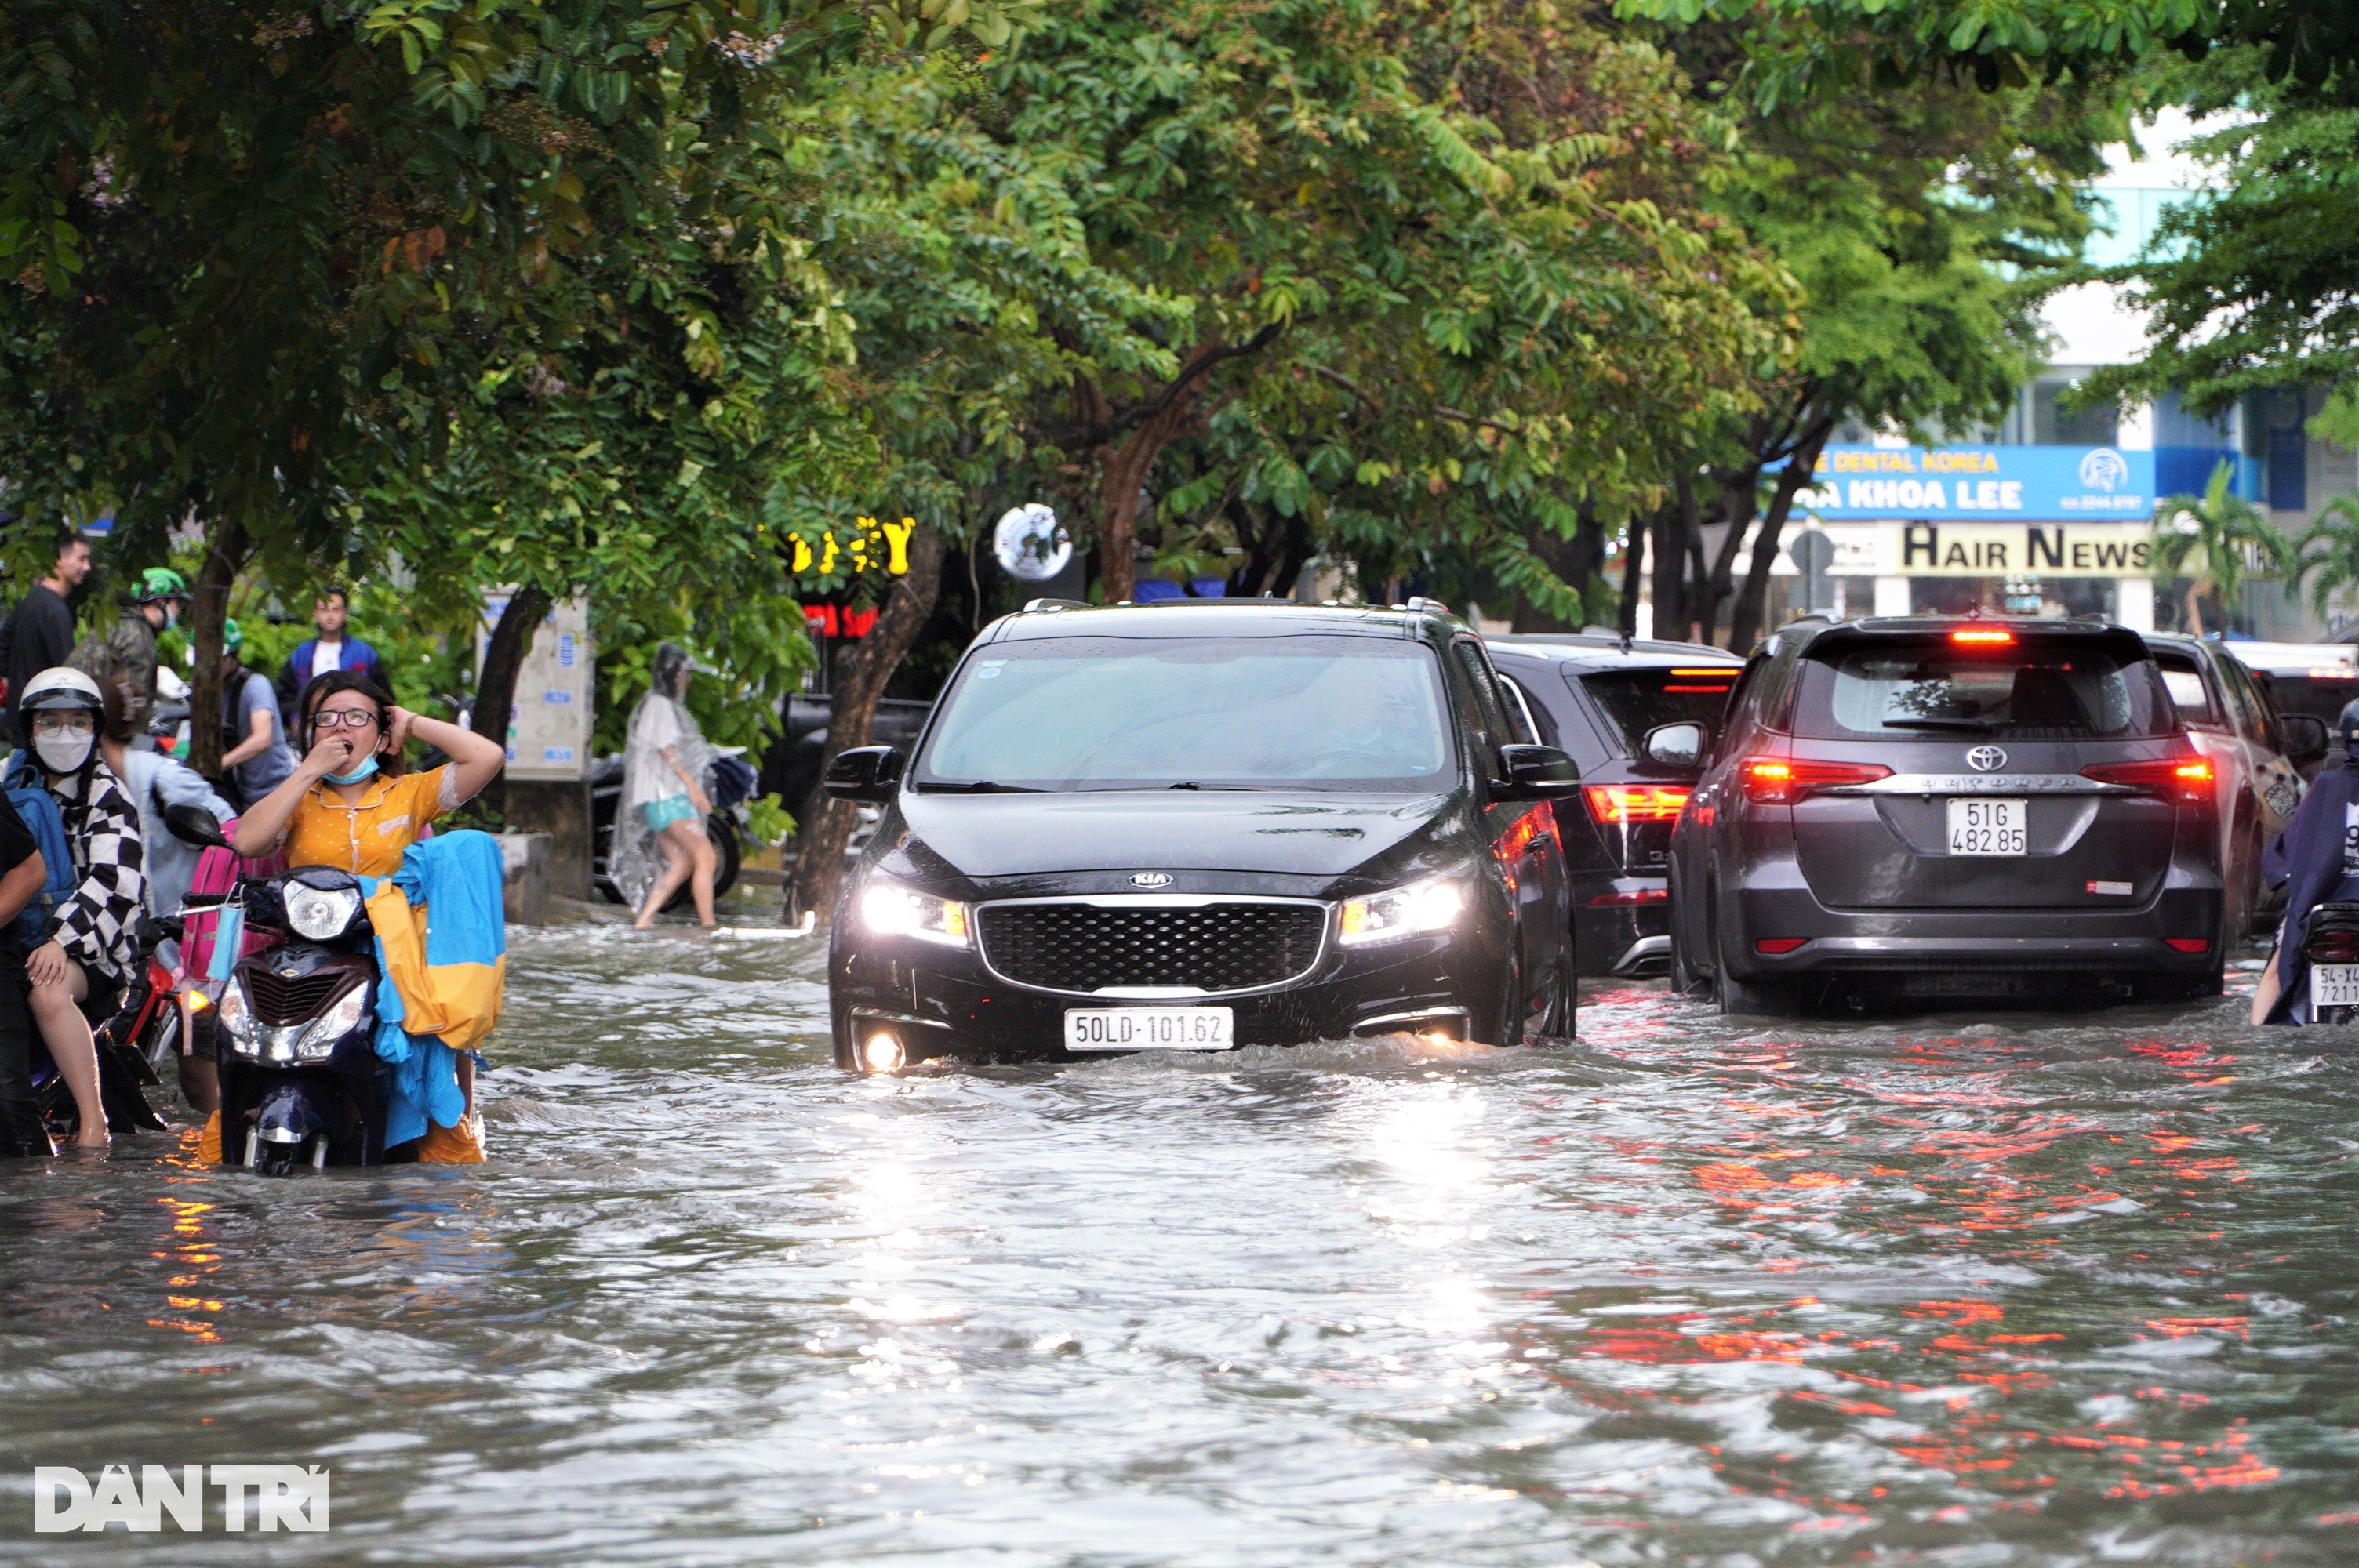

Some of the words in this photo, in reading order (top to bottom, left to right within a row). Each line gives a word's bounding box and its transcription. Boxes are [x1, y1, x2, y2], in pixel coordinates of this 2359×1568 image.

[1834, 451, 1917, 473] DENTAL
[1922, 451, 1998, 474] KOREA
[1848, 479, 1947, 509] KHOA
[1957, 480, 2023, 510] LEE
[1967, 804, 2008, 826] 51G
[1952, 829, 2024, 852] 482.85
[1135, 873, 1167, 884] KIA
[2321, 967, 2359, 984] 54-X4
[1076, 1015, 1222, 1043] 50LD-101.62
